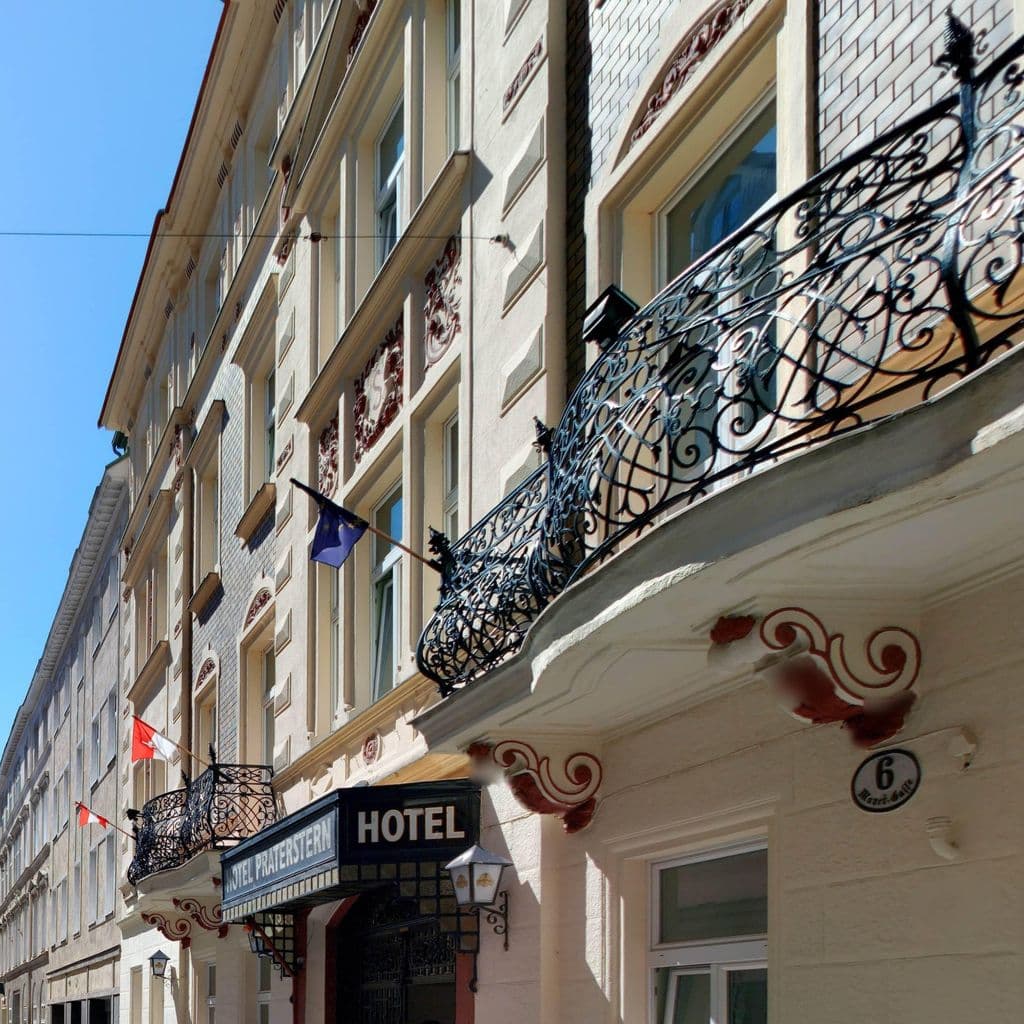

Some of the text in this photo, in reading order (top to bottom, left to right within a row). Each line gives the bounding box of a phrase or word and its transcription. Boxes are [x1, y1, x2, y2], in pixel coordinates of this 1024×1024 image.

[876, 756, 894, 790] 6
[357, 805, 466, 844] HOTEL
[226, 817, 332, 893] HOTEL PRATERSTERN
